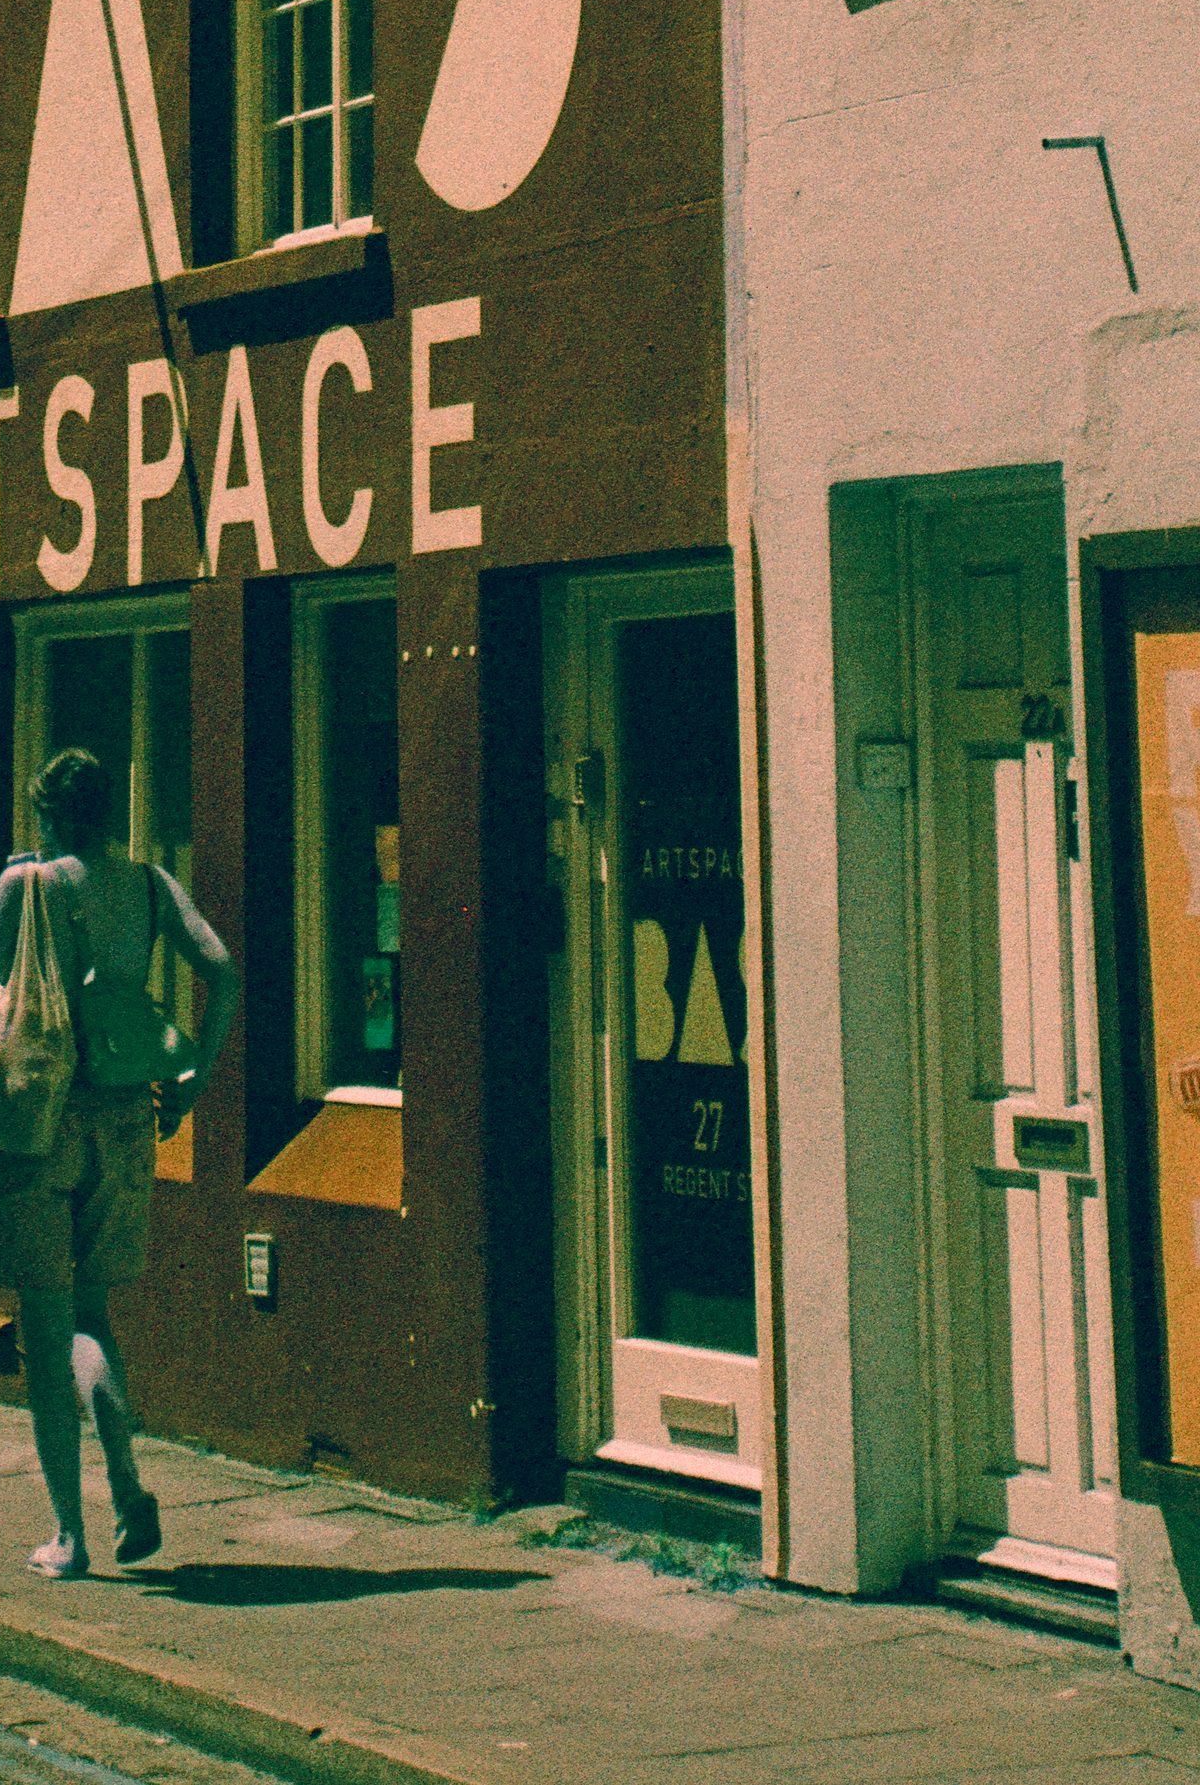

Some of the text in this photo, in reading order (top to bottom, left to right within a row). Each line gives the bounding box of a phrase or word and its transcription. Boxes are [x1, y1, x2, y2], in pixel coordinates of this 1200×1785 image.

[633, 918, 749, 1067] BA
[693, 1099, 723, 1153] 27
[663, 1164, 752, 1203] REGENT S
